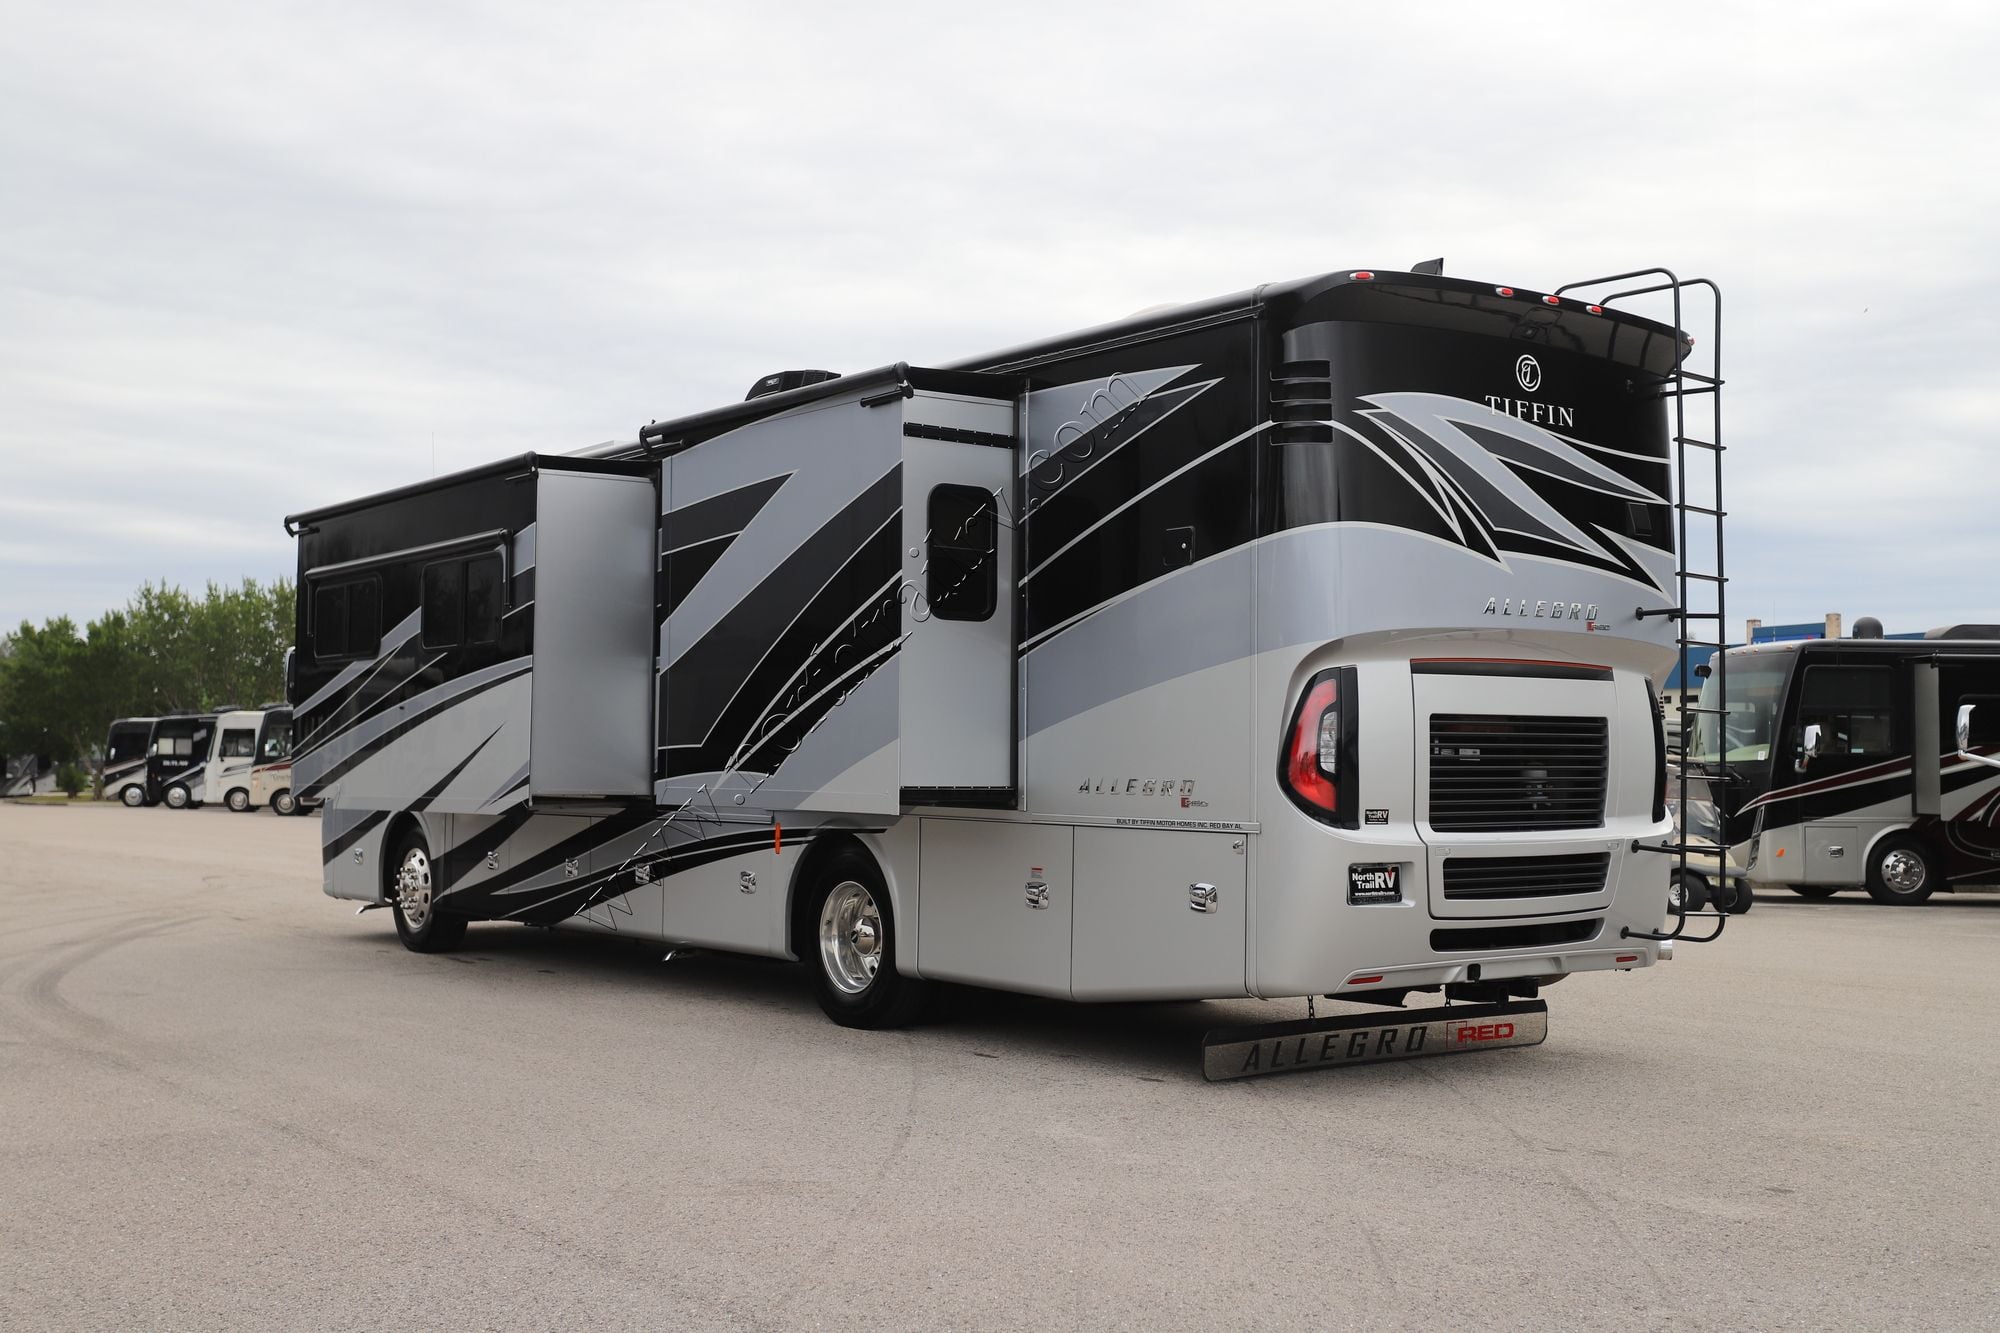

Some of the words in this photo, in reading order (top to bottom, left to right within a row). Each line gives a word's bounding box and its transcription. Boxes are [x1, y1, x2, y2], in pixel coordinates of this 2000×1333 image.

[1485, 395, 1574, 427] TIFFIN
[1482, 597, 1599, 621] ALLEGRO
[1078, 777, 1196, 796] ALLEGRO
[1378, 810, 1388, 819] RV
[1352, 872, 1375, 881] North
[1356, 881, 1375, 889] Trail
[1374, 872, 1395, 889] RV
[1241, 1026, 1427, 1073] ALLEGRO
[1457, 1022, 1514, 1043] RED
